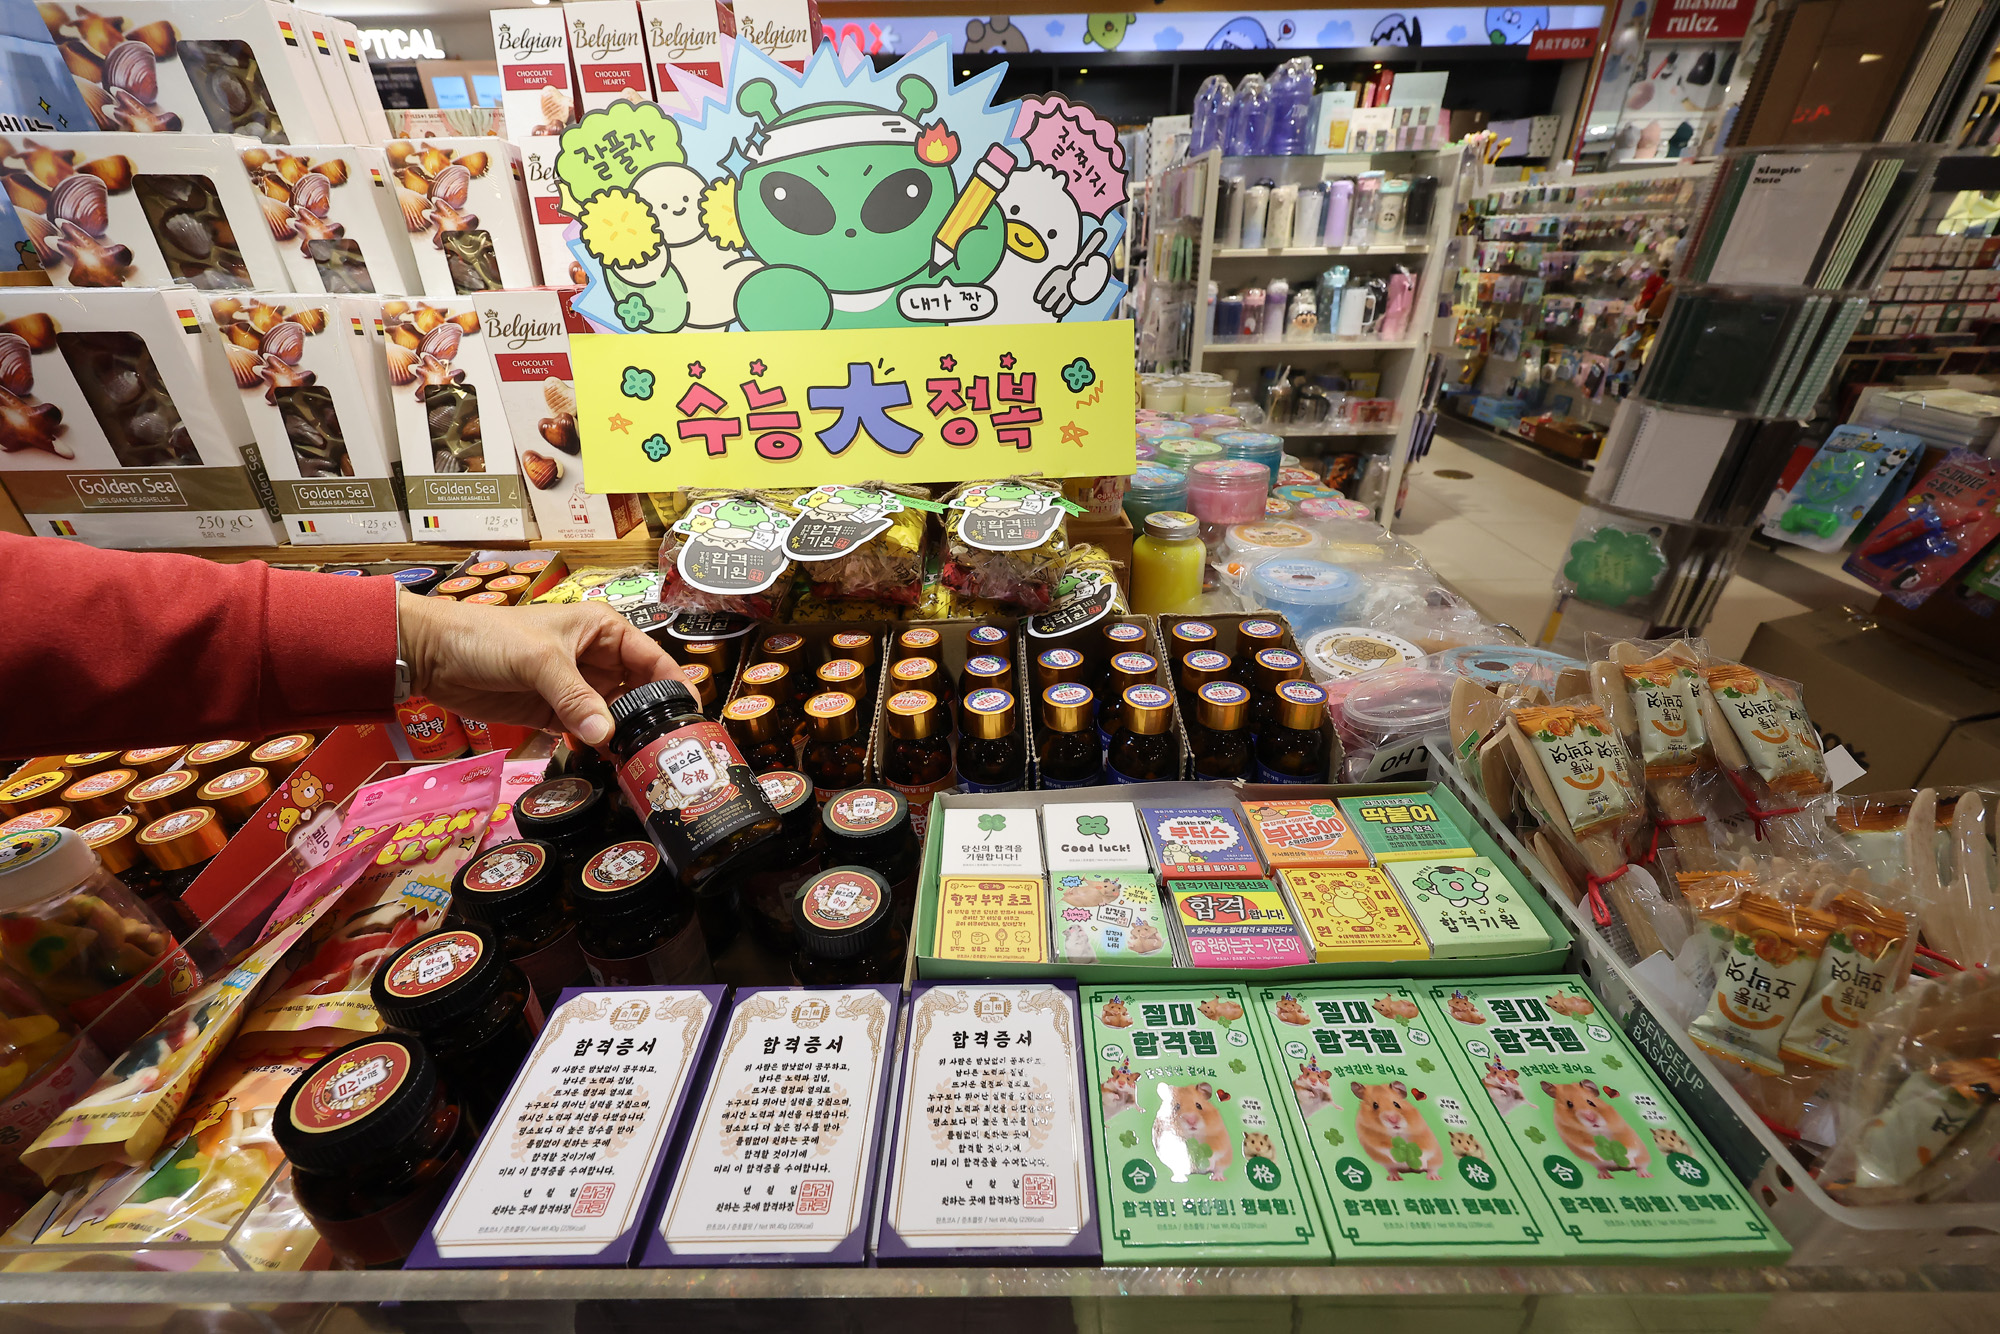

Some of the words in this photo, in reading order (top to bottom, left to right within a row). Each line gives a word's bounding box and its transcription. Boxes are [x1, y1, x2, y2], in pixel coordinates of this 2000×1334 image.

[498, 28, 563, 60] Belgian
[573, 25, 639, 60] Belgian
[651, 23, 717, 59] Belgian
[741, 22, 808, 55] Belgian
[594, 70, 631, 78] CHOCOLATE
[603, 78, 626, 86] HEARTS
[574, 129, 655, 180] 잘풀자
[1052, 125, 1106, 197] 잘찍자
[1757, 166, 1802, 175] Simple
[910, 294, 952, 311] 내가
[961, 292, 982, 313] 짱
[484, 314, 563, 350] Belgian
[677, 379, 803, 459] 수능
[807, 362, 923, 455] 大
[926, 369, 1042, 450] 정복
[246, 448, 262, 471] Sea
[79, 478, 141, 495] Golden
[143, 478, 176, 494] Sea
[257, 473, 280, 517] Golden
[299, 487, 346, 499] Golden
[348, 487, 369, 498] Sea
[429, 483, 473, 495] Golden
[475, 483, 496, 495] Sea
[196, 515, 224, 529] 250
[361, 519, 379, 529] 125
[484, 516, 500, 525] 125
[988, 519, 1022, 529] 합격
[810, 524, 843, 536] 합격
[990, 529, 1022, 539] 기원
[807, 535, 838, 548] 기원
[712, 551, 748, 564] 합격
[712, 566, 747, 580] 기원
[1646, 692, 1684, 708] 호박엿
[1549, 742, 1593, 763] 호박엿
[1571, 759, 1595, 775] 전통
[681, 770, 709, 785] 合格
[1360, 805, 1439, 824] 딱붙어
[1169, 826, 1229, 839] 부터스
[1261, 818, 1344, 844] 부터500
[966, 853, 1019, 861] 기원합니다!
[995, 845, 1023, 853] 합격을
[1061, 844, 1094, 853] Good
[1100, 844, 1131, 852] luck!
[951, 893, 977, 906] 합격
[981, 894, 1003, 906] 부적
[1007, 894, 1032, 906] 초코
[1186, 895, 1247, 921] 합격
[1248, 909, 1285, 920] 합니다!
[1440, 914, 1520, 933] 합격기원
[1726, 957, 1796, 1000] 호박엿
[1733, 987, 1771, 1013] 전통
[1142, 1004, 1196, 1027] 절대
[1315, 1002, 1374, 1024] 절대
[1487, 999, 1550, 1023] 절대
[573, 1037, 657, 1057] 합격증서
[763, 1036, 843, 1054] 합격증서
[952, 1030, 1032, 1049] 합격증서
[1132, 1030, 1217, 1056] 합격햄
[1312, 1028, 1403, 1054] 합격햄
[1490, 1026, 1586, 1054] 합격햄
[1633, 1026, 1684, 1087] BASKET
[1638, 1012, 1704, 1089] SENSE-UP
[755, 1063, 778, 1071] 사람은
[815, 1063, 850, 1071] 공부하고,
[785, 1074, 809, 1082] 노력과
[752, 1086, 777, 1094] 뜨거운
[726, 1098, 759, 1107] 누구보다
[750, 1110, 775, 1118] 노력과
[778, 1110, 802, 1118] 최선을
[802, 1136, 819, 1145] 곳에
[744, 1150, 769, 1159] 합격할
[773, 1150, 807, 1159] 것이기에
[714, 1164, 730, 1173] 미리
[734, 1164, 742, 1173] 이
[746, 1164, 780, 1174] 합격증을
[784, 1164, 831, 1173] 수여합니다.
[1129, 1167, 1150, 1185] 合
[1253, 1164, 1275, 1184] 格
[1342, 1165, 1364, 1184] 合
[1466, 1163, 1490, 1184] 格
[1551, 1163, 1574, 1182] 合
[1675, 1160, 1701, 1180] 格
[743, 1185, 751, 1195] 년
[790, 1185, 797, 1195] 일
